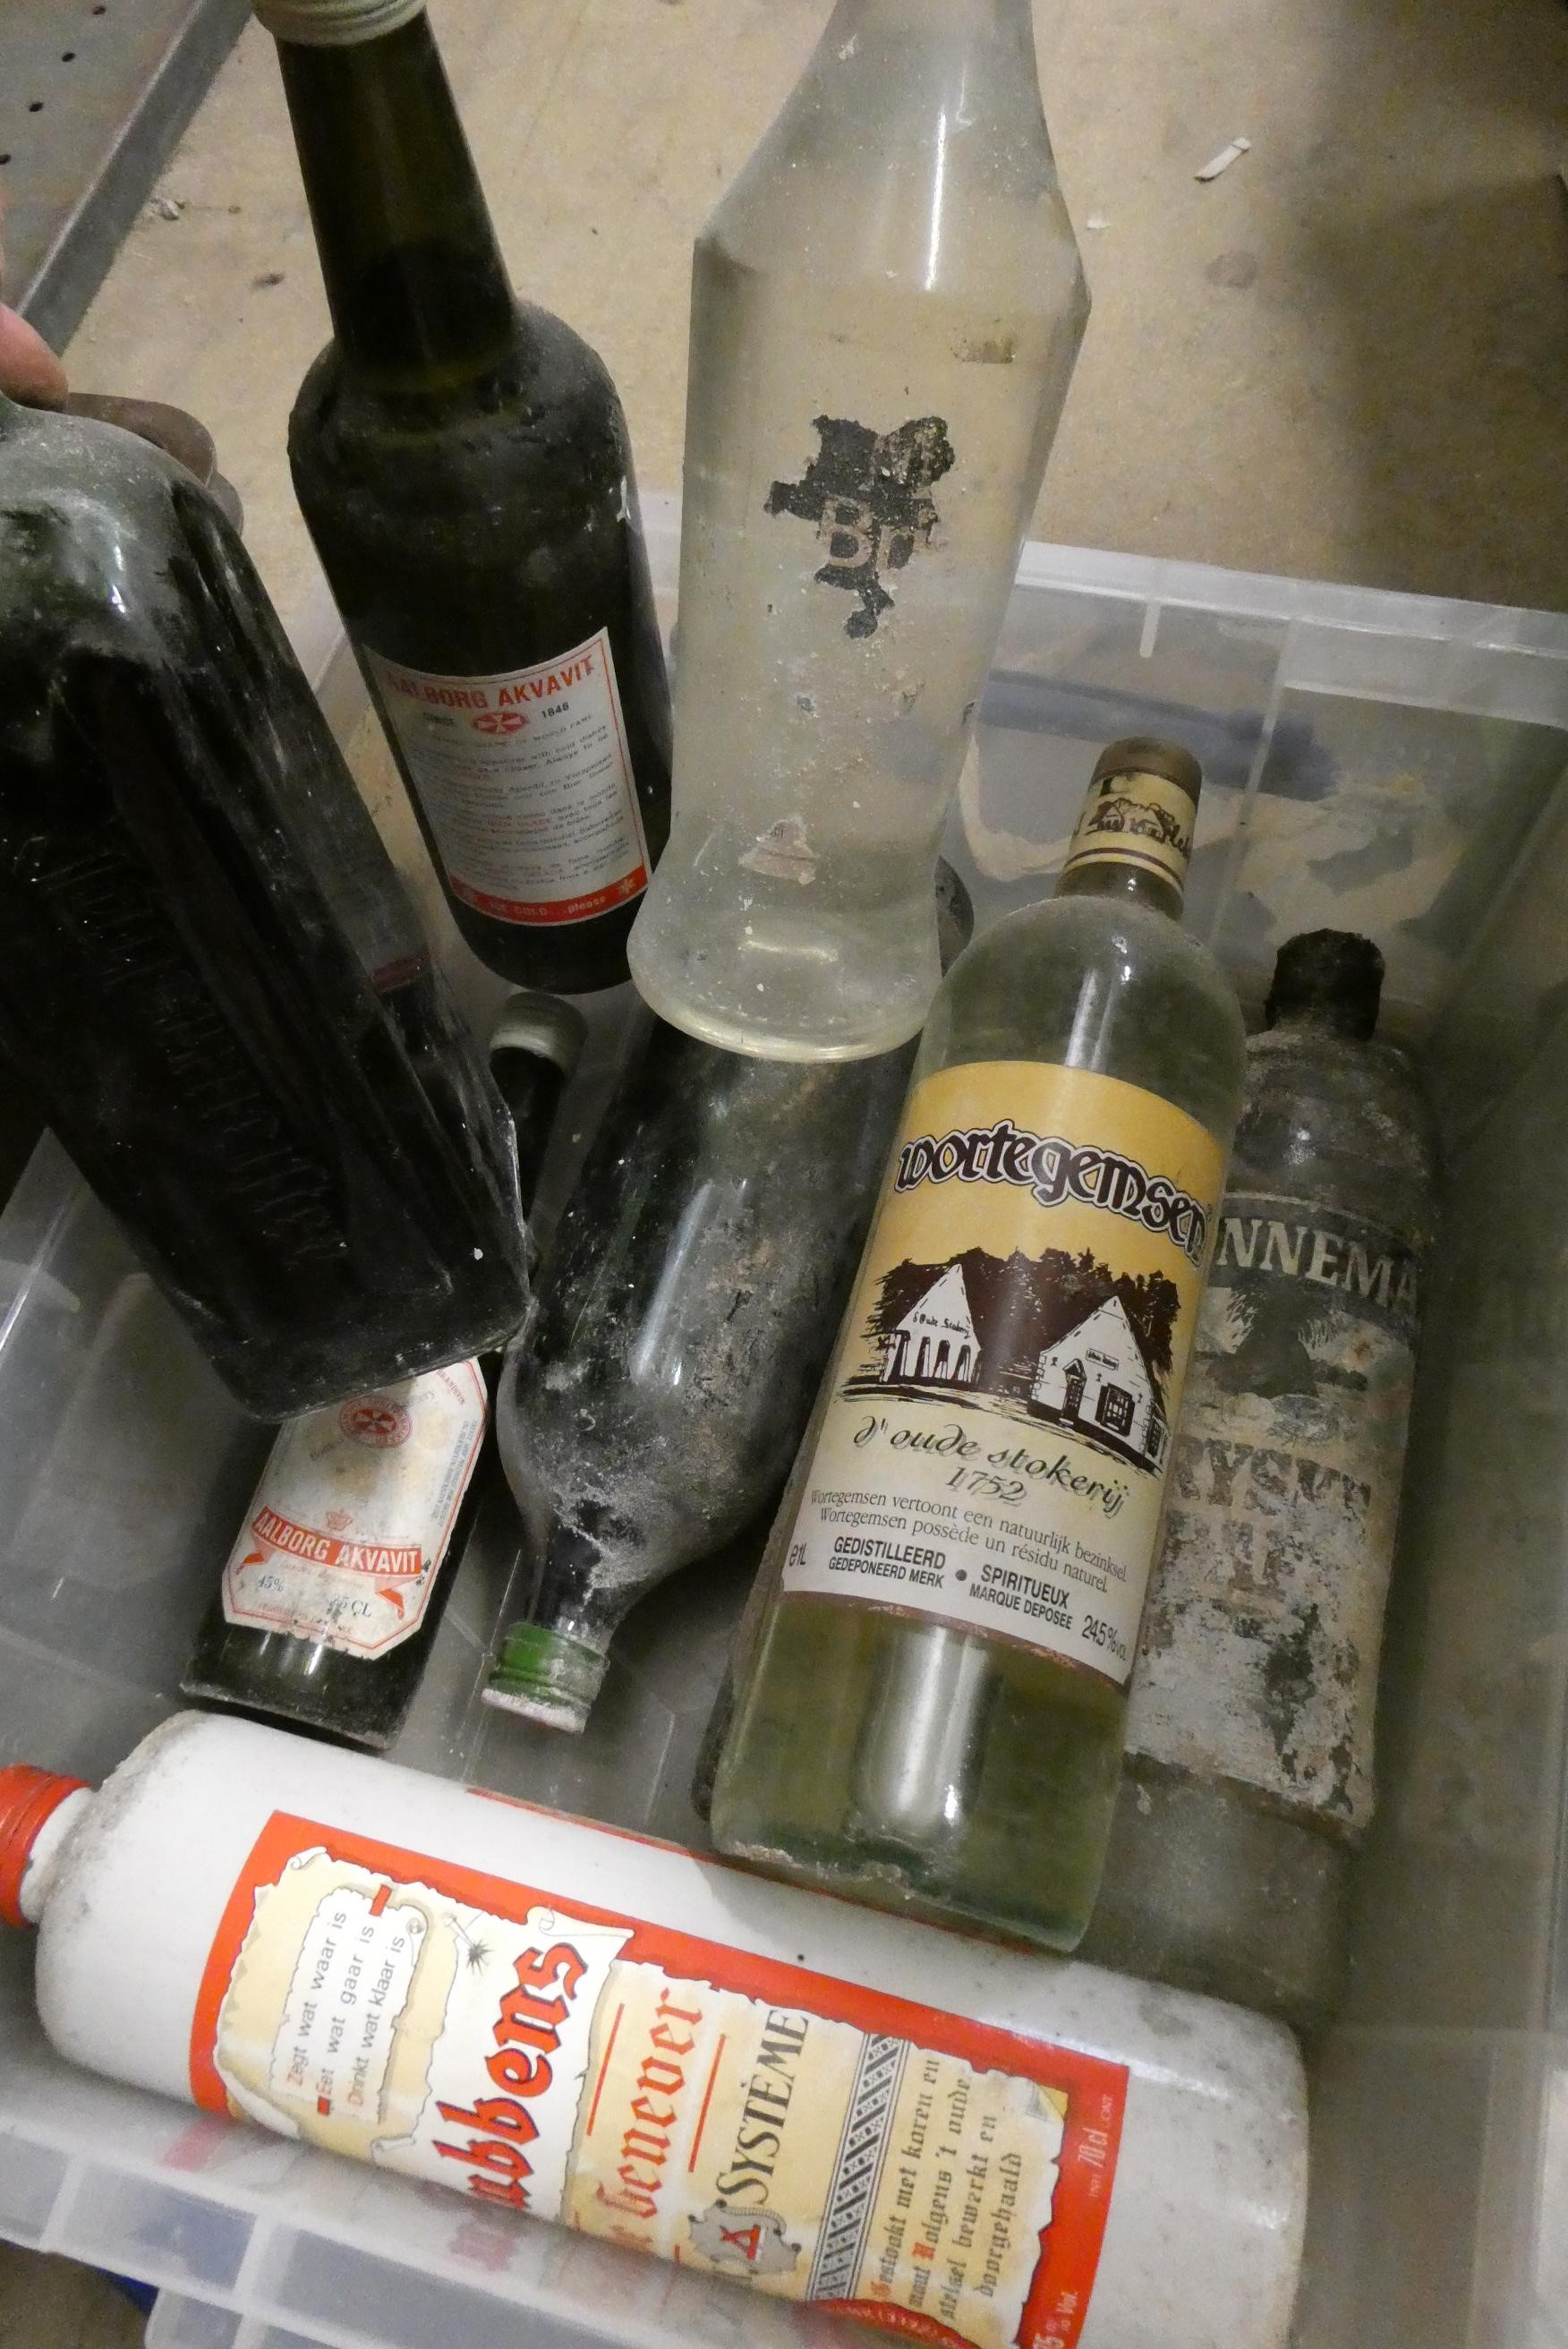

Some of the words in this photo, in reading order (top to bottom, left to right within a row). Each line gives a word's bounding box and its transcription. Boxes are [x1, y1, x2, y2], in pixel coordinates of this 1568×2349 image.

[499, 655, 596, 707] AKVAVIT
[946, 1466, 1026, 1504] 1752
[987, 1448, 1130, 1519] stokerij
[253, 1510, 331, 1561] AALBORG
[335, 1545, 418, 1574] AKVAVIT
[811, 1490, 887, 1508] Wortegemsen
[892, 1496, 959, 1519] vertoont
[963, 1508, 993, 1528] een
[999, 1519, 1071, 1555] natuurlijk
[821, 1507, 908, 1529] Wortegemsen
[912, 1519, 979, 1546] possède
[985, 1536, 1005, 1553] un
[1011, 1542, 1059, 1571] résidu
[829, 1556, 907, 1580] GEDEPONEERD
[908, 1568, 946, 1589] MERK
[969, 1583, 1021, 1612] MARQUE
[1023, 1600, 1074, 1631] DEPOSEE
[834, 1535, 947, 1570] GEDISTILLEERD
[981, 1564, 1070, 1610] SPIRITUEUX
[351, 1599, 372, 1618] CL
[327, 1911, 347, 1929] is
[386, 1935, 405, 1954] is
[311, 1937, 337, 1990] waar
[368, 1959, 396, 2007] klaar
[297, 2001, 317, 2037] wat
[315, 2067, 335, 2097] Eet
[326, 2016, 346, 2054] wat
[340, 1953, 364, 2005] gaar
[359, 1926, 375, 1944] is
[361, 2012, 380, 2049] wat
[287, 2046, 309, 2087] Zegt
[347, 2055, 370, 2107] Drinkt
[432, 1943, 588, 2209] ubbens
[924, 2060, 941, 2086] en
[900, 2093, 933, 2160] koren
[947, 2078, 971, 2136] oude
[979, 2115, 998, 2142] en
[896, 2166, 918, 2209] met
[972, 2151, 1023, 2298] doorgehaald
